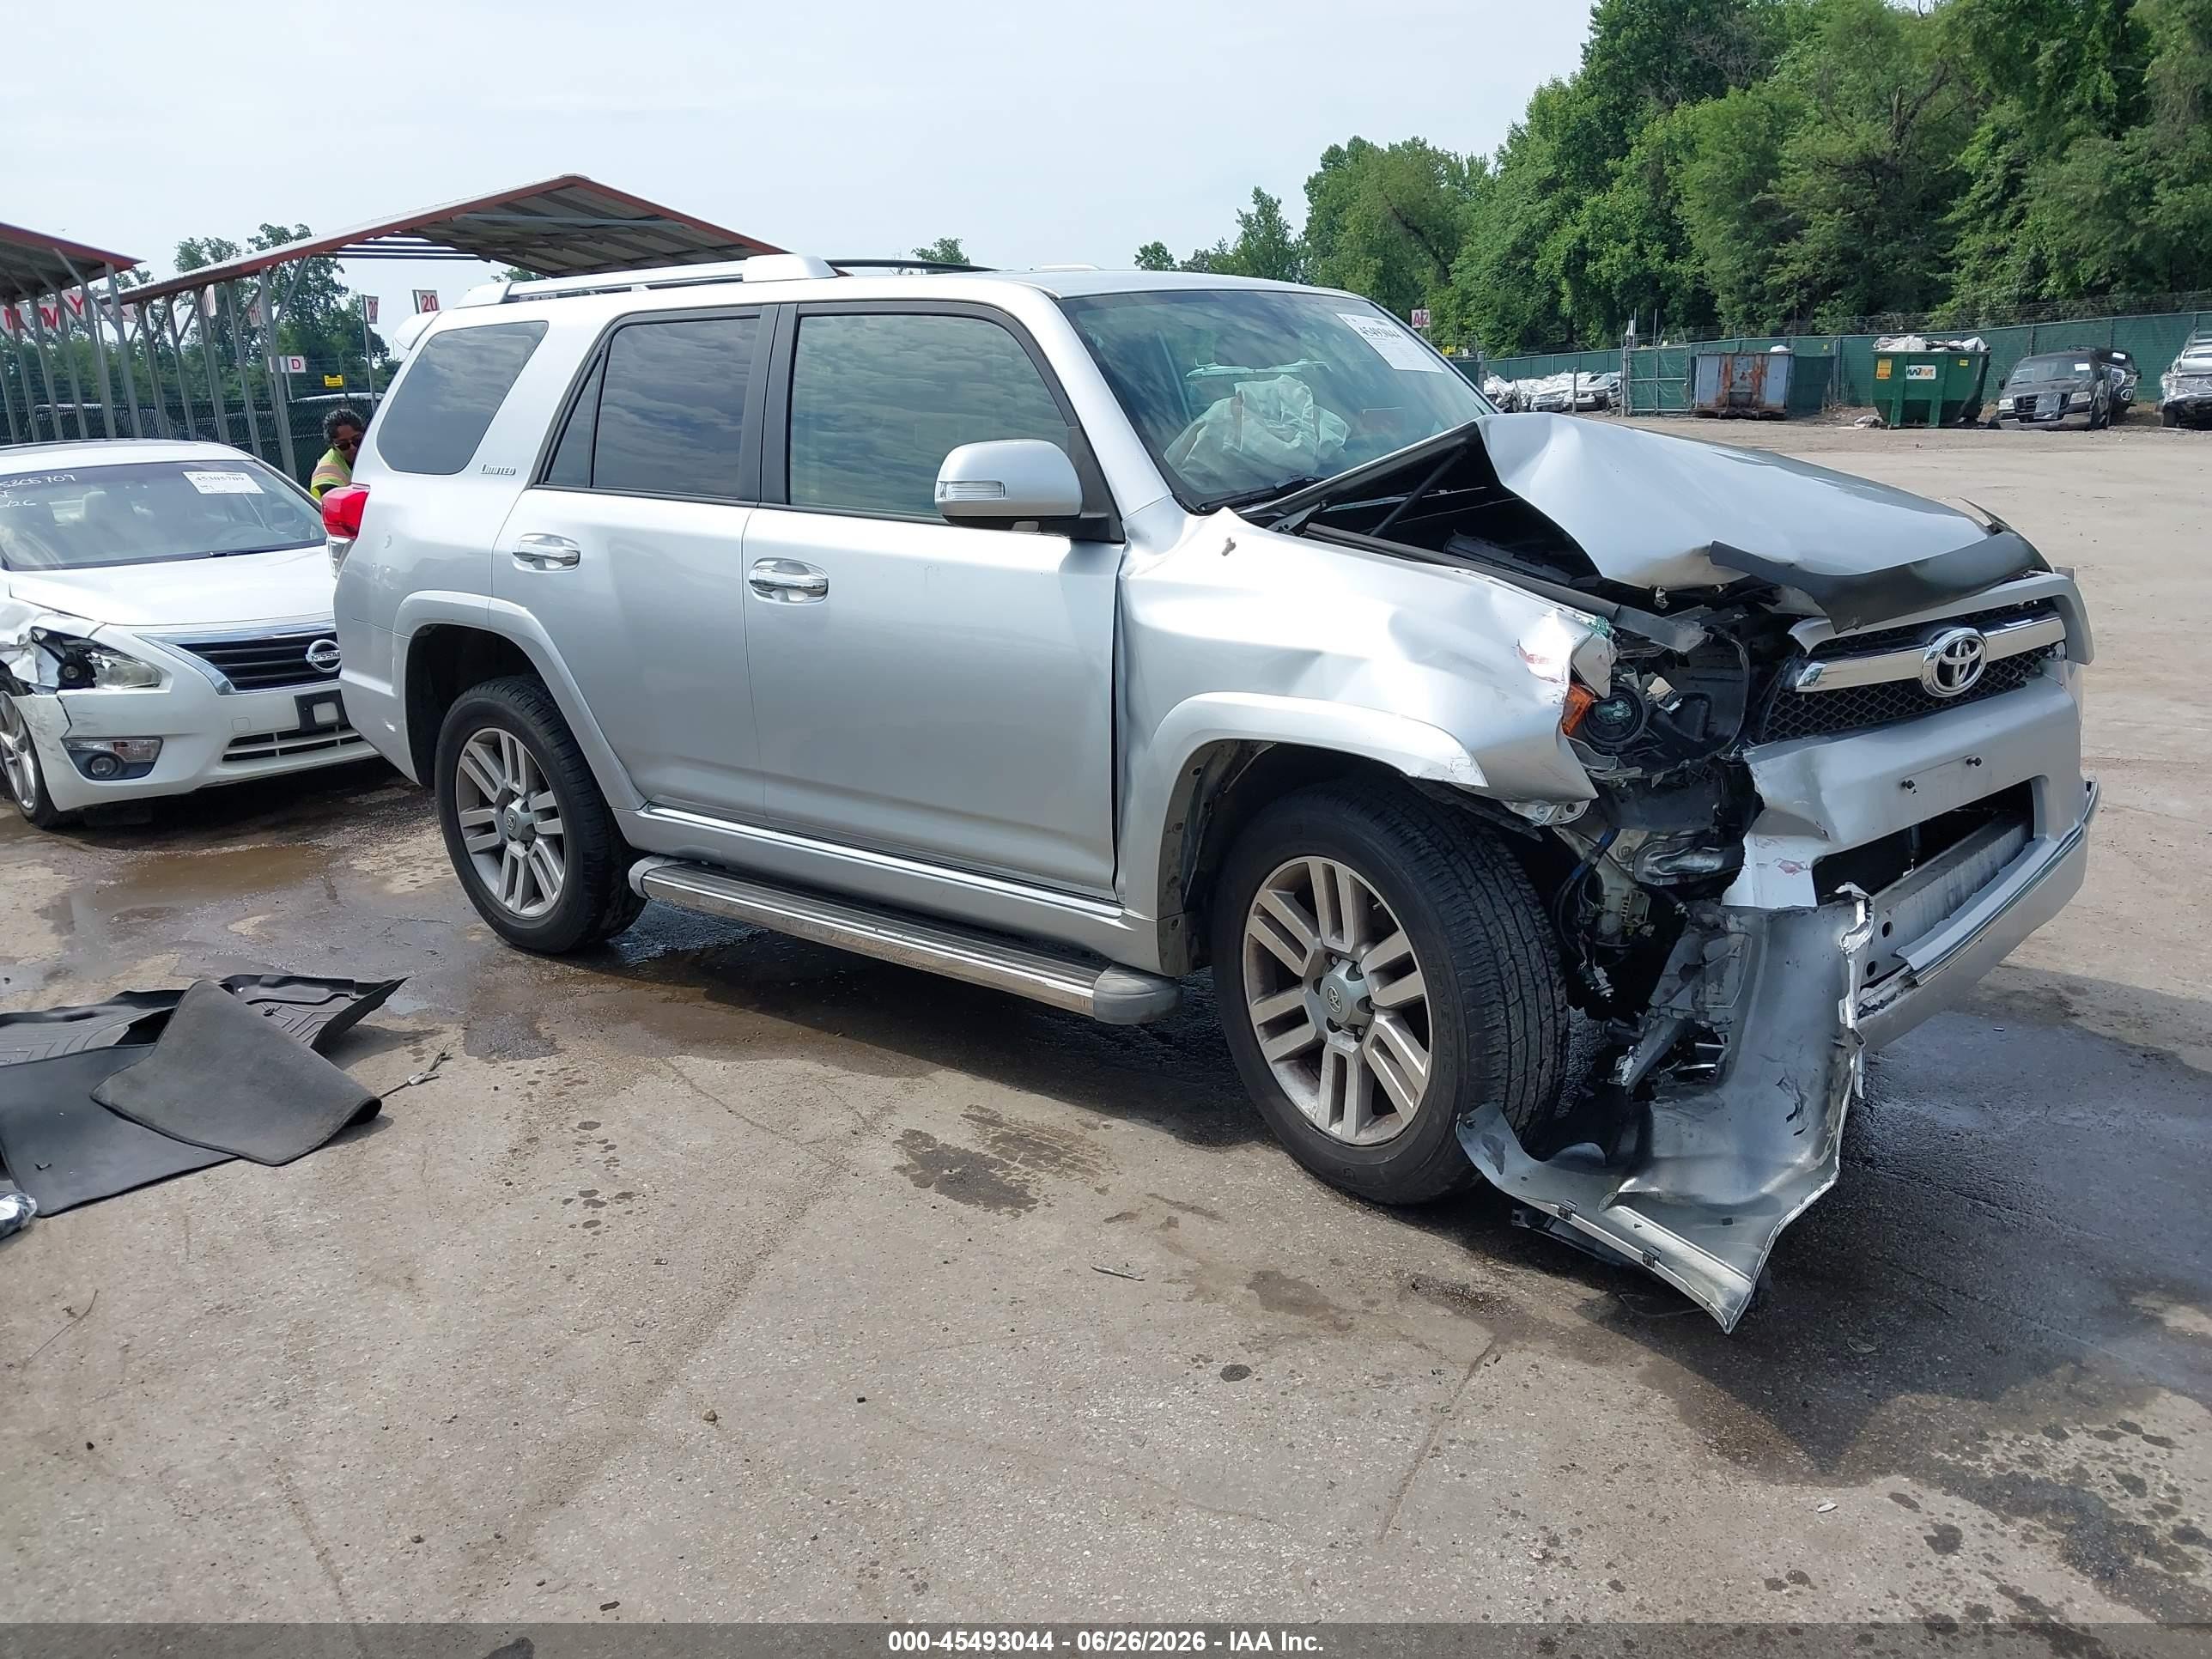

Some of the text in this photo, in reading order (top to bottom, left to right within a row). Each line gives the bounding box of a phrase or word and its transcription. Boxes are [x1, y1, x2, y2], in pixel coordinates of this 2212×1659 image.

[68, 295, 83, 315] Y
[368, 301, 378, 319] 20
[421, 295, 438, 312] 20
[291, 358, 301, 370] D
